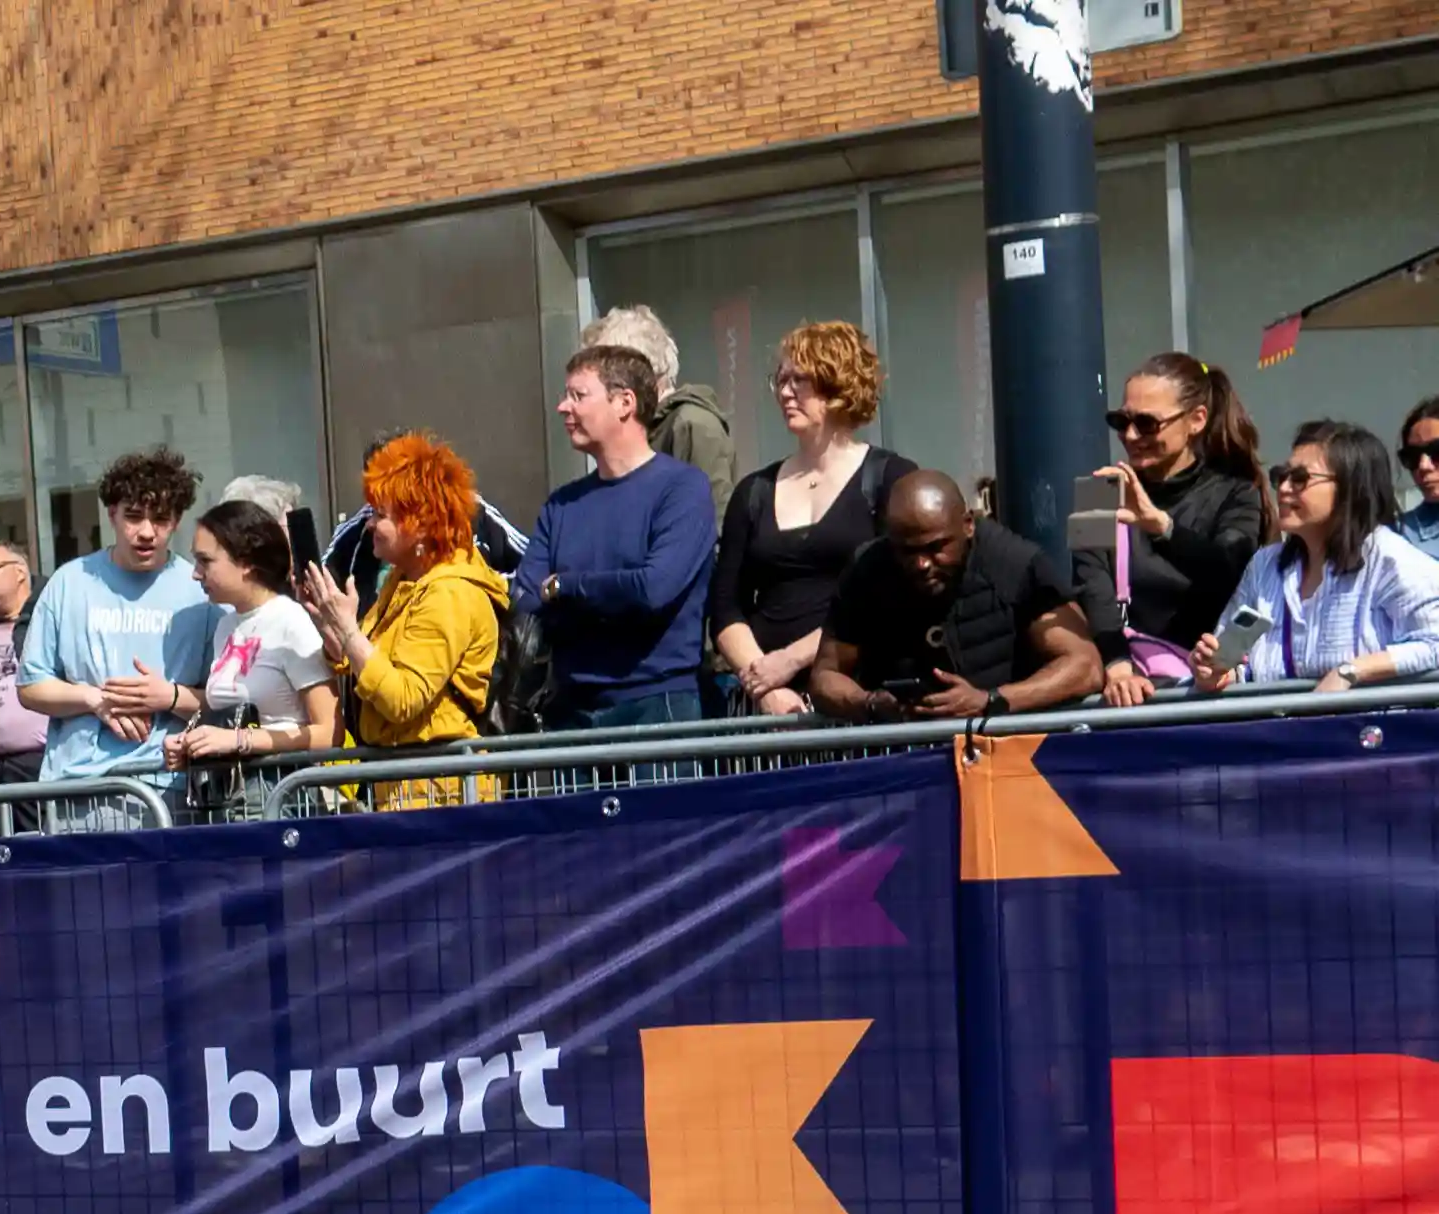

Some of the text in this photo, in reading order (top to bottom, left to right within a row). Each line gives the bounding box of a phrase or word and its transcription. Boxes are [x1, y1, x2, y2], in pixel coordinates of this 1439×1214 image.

[1012, 246, 1037, 260] 140
[25, 1073, 171, 1156] en
[204, 1031, 565, 1152] buurt
